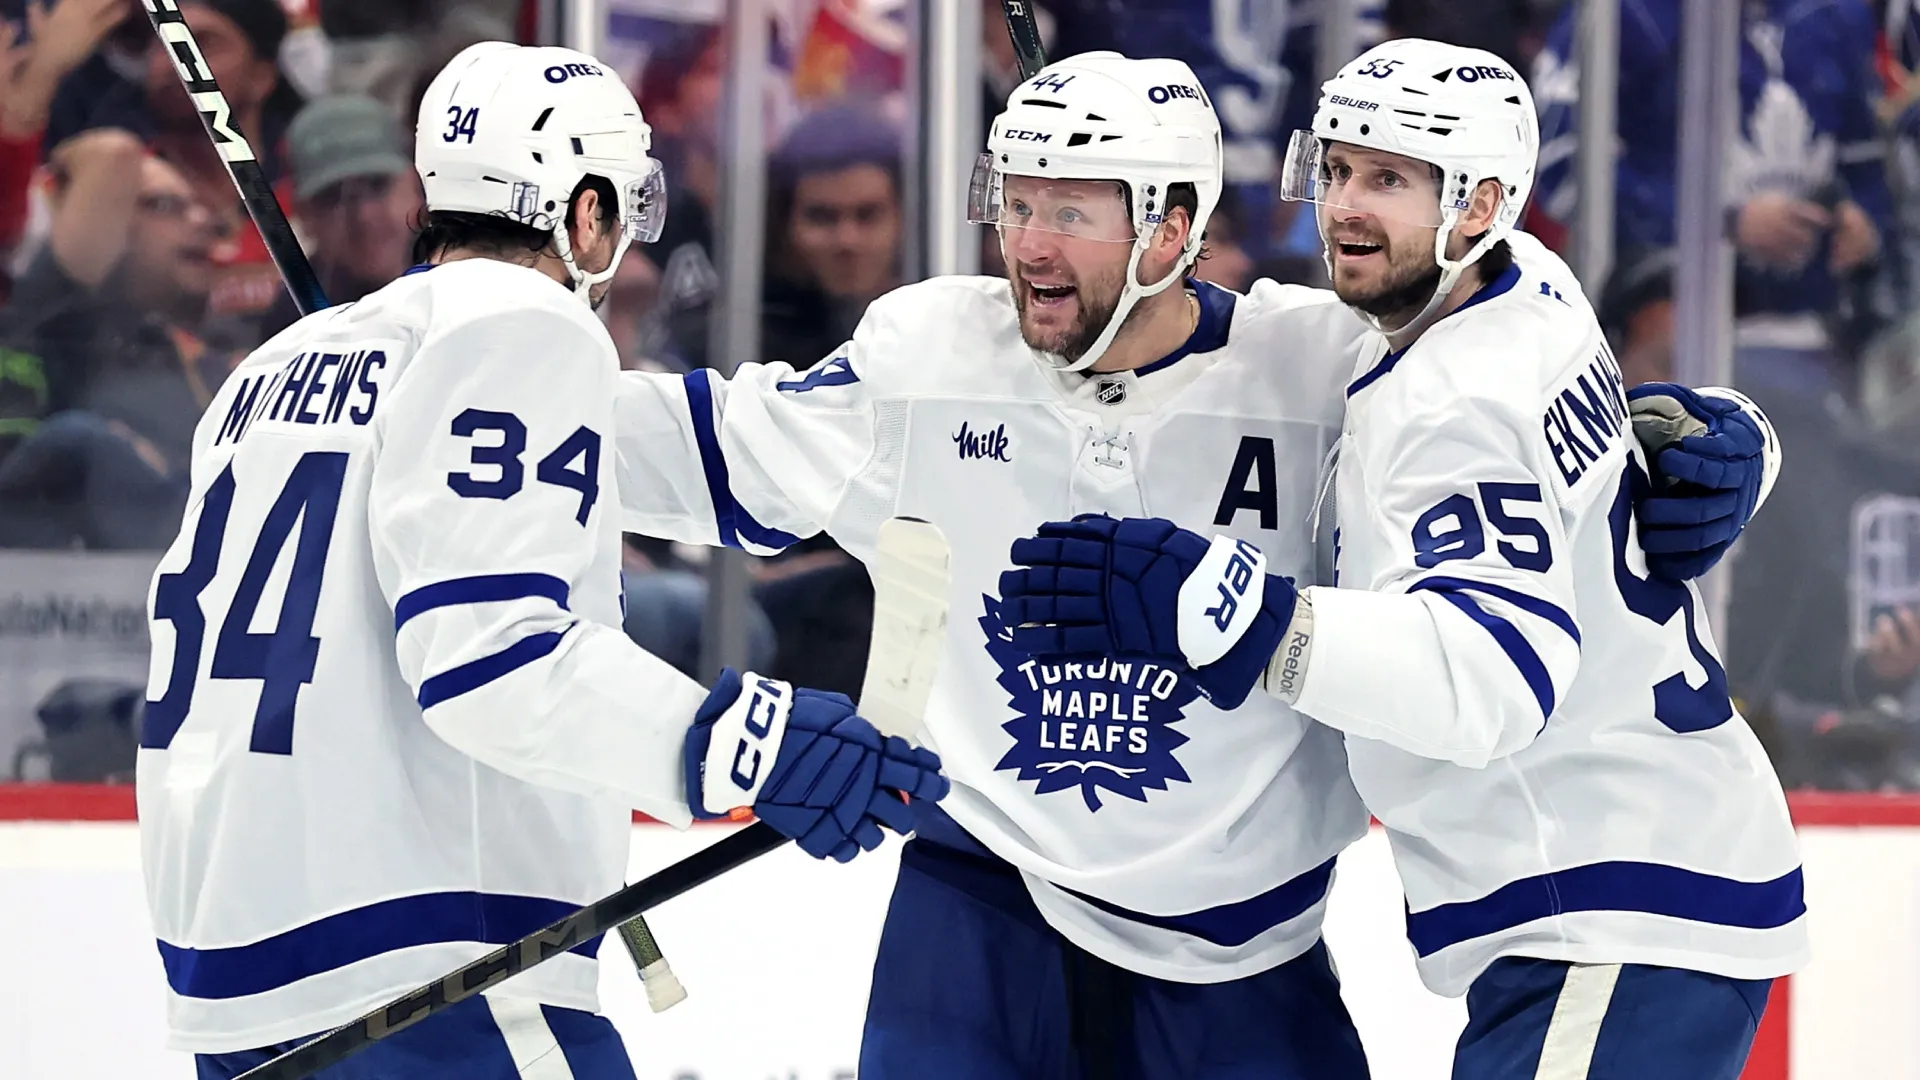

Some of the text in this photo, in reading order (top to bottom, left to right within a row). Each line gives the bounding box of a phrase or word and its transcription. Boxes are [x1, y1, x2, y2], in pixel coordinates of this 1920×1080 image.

[1149, 84, 1199, 104] OREO
[442, 105, 480, 144] 34
[1004, 129, 1053, 143] CCM
[1101, 386, 1121, 401] NHL
[951, 421, 1013, 463] Milk
[447, 408, 601, 529] 34
[1213, 436, 1278, 530] A
[1411, 482, 1554, 574] 95
[140, 452, 350, 757] 34
[1017, 657, 1179, 701] TORONTO
[1279, 631, 1310, 697] Reebok
[1041, 688, 1150, 722] MAPLE
[1039, 720, 1149, 754] LEAFS
[366, 906, 597, 1040] CCM
